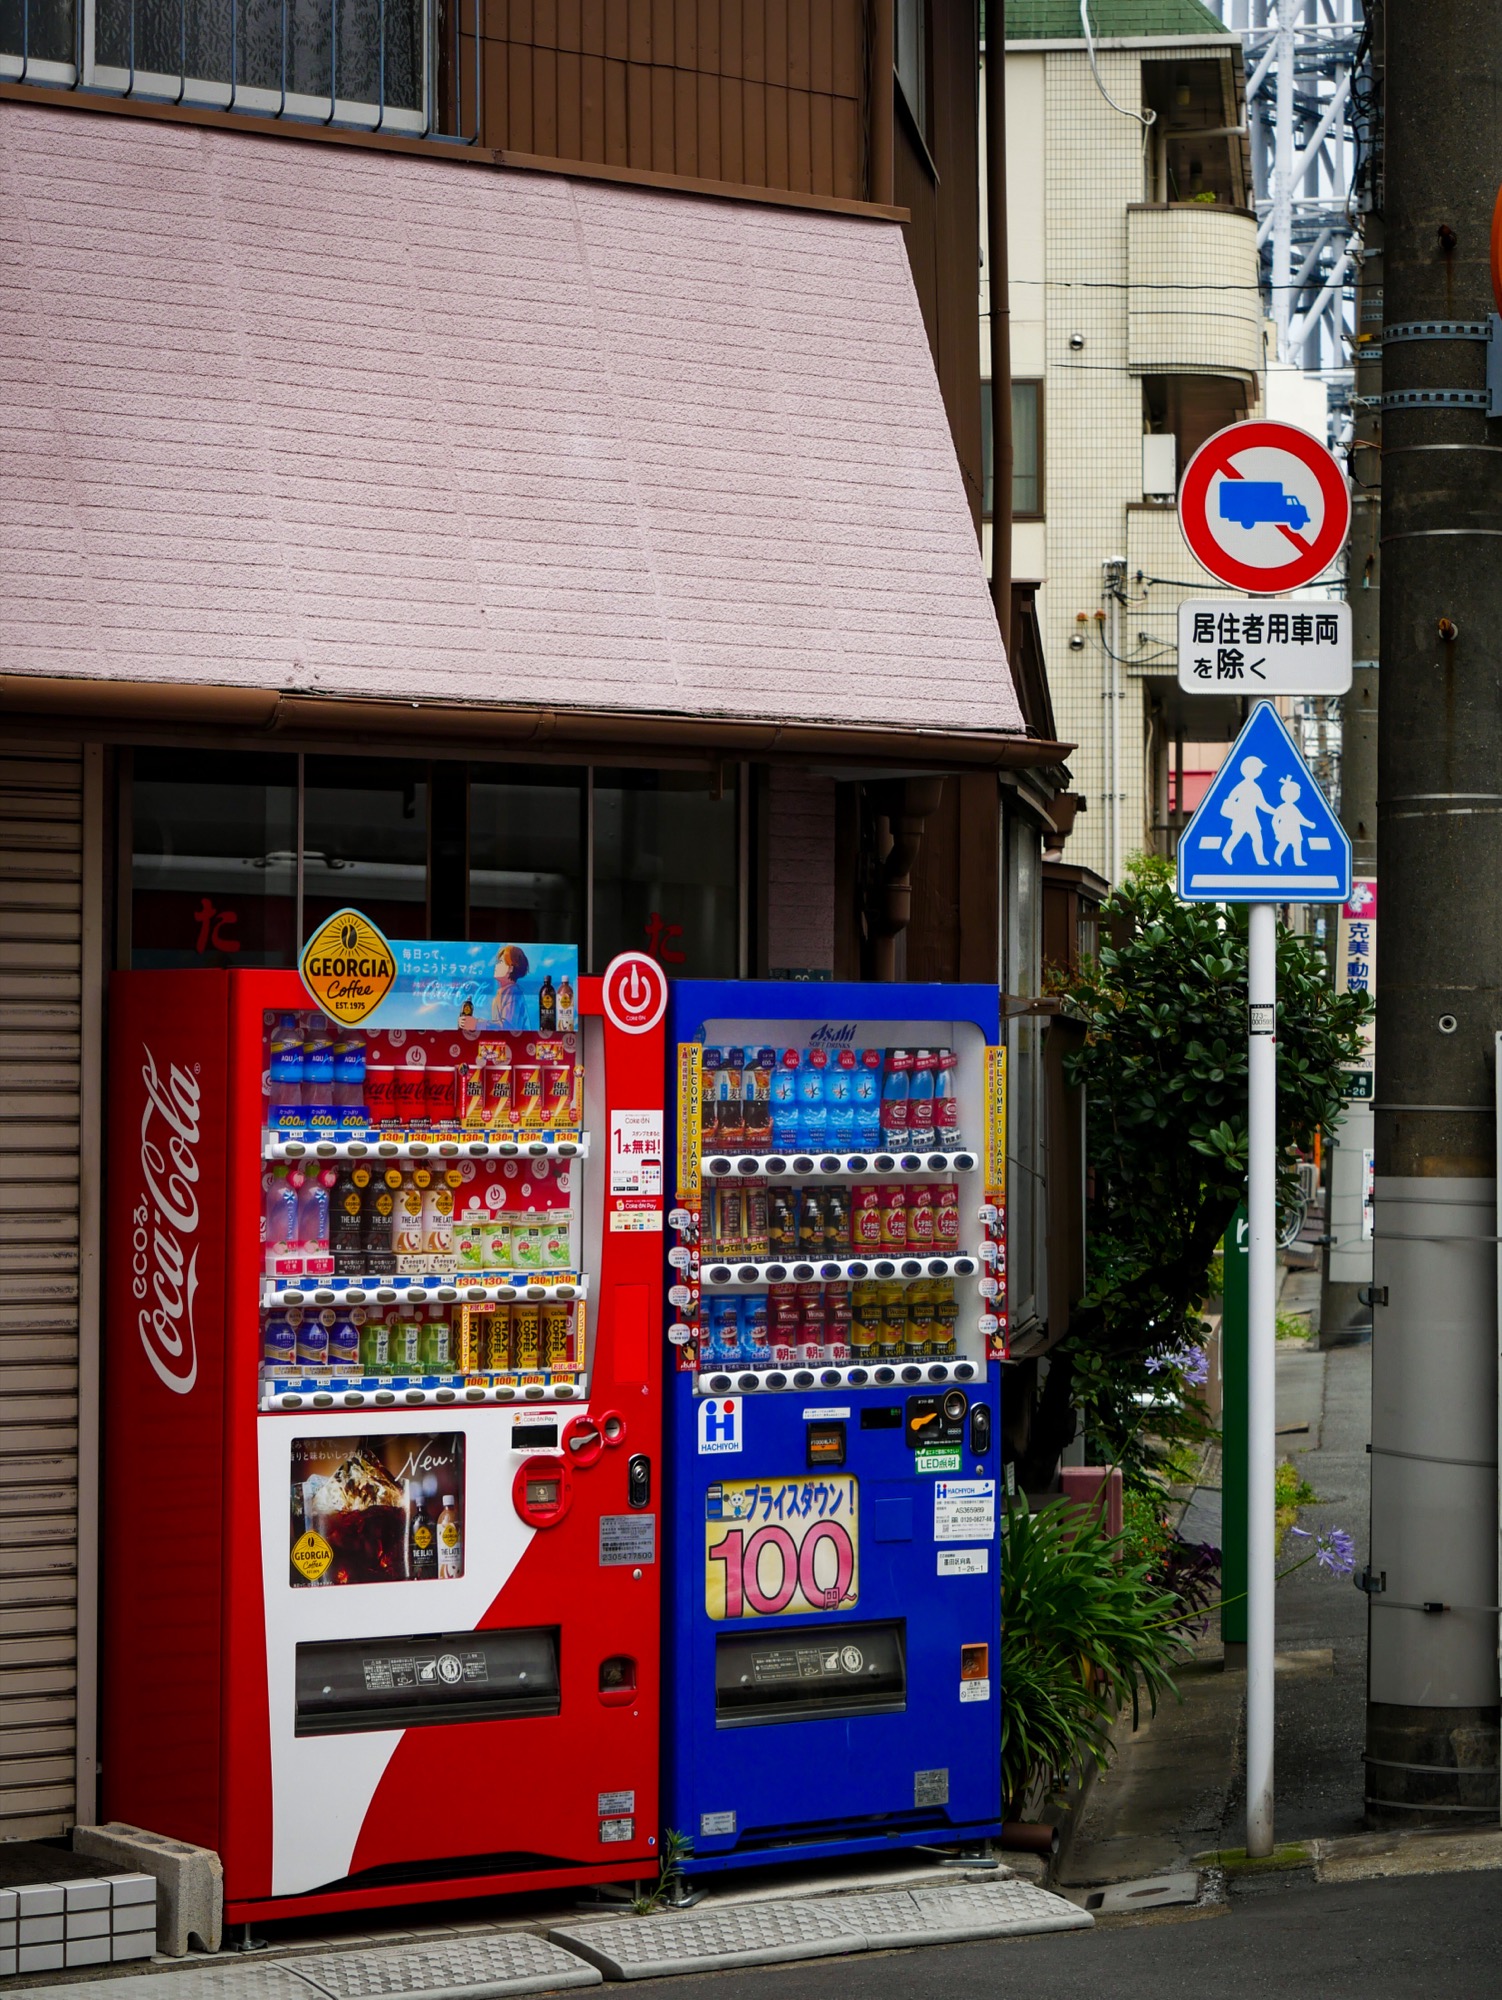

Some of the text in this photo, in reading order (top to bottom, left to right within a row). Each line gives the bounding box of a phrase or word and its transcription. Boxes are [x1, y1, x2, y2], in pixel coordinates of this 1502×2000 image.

[1192, 613, 1339, 646] 居住者用車両
[1193, 648, 1267, 680] を除く
[193, 897, 241, 955] た
[644, 911, 687, 963] た
[402, 948, 445, 960] 毎日って、
[309, 957, 390, 978] GEORGIA
[402, 963, 484, 975] けっこうドラマだ。
[326, 979, 374, 999] Coffee
[335, 1002, 365, 1010] EST. 1975
[810, 1023, 858, 1042] Asahi
[690, 1047, 699, 1114] WELCOME
[996, 1050, 1004, 1114] WELCOME
[691, 1121, 697, 1135] TO
[997, 1120, 1002, 1135] TO
[381, 1133, 403, 1142] 130円
[409, 1133, 432, 1142] 130円
[435, 1133, 457, 1142] 130円
[461, 1133, 483, 1142] 130円
[490, 1133, 513, 1142] 130円
[519, 1133, 541, 1142] 130円
[555, 1133, 577, 1142] 130円
[138, 1041, 200, 1394] Coca-Cola
[466, 1377, 488, 1385] 100円
[495, 1377, 516, 1385] 100円
[522, 1376, 543, 1384] 100円
[701, 1442, 739, 1452] HACHIYOH
[394, 1434, 457, 1481] New!
[920, 1457, 957, 1469] LED照明
[744, 1480, 855, 1522] プライスダウン！
[294, 1550, 330, 1561] GEORGIA
[302, 1560, 323, 1570] Coffee
[958, 1564, 983, 1573] 1-26-1
